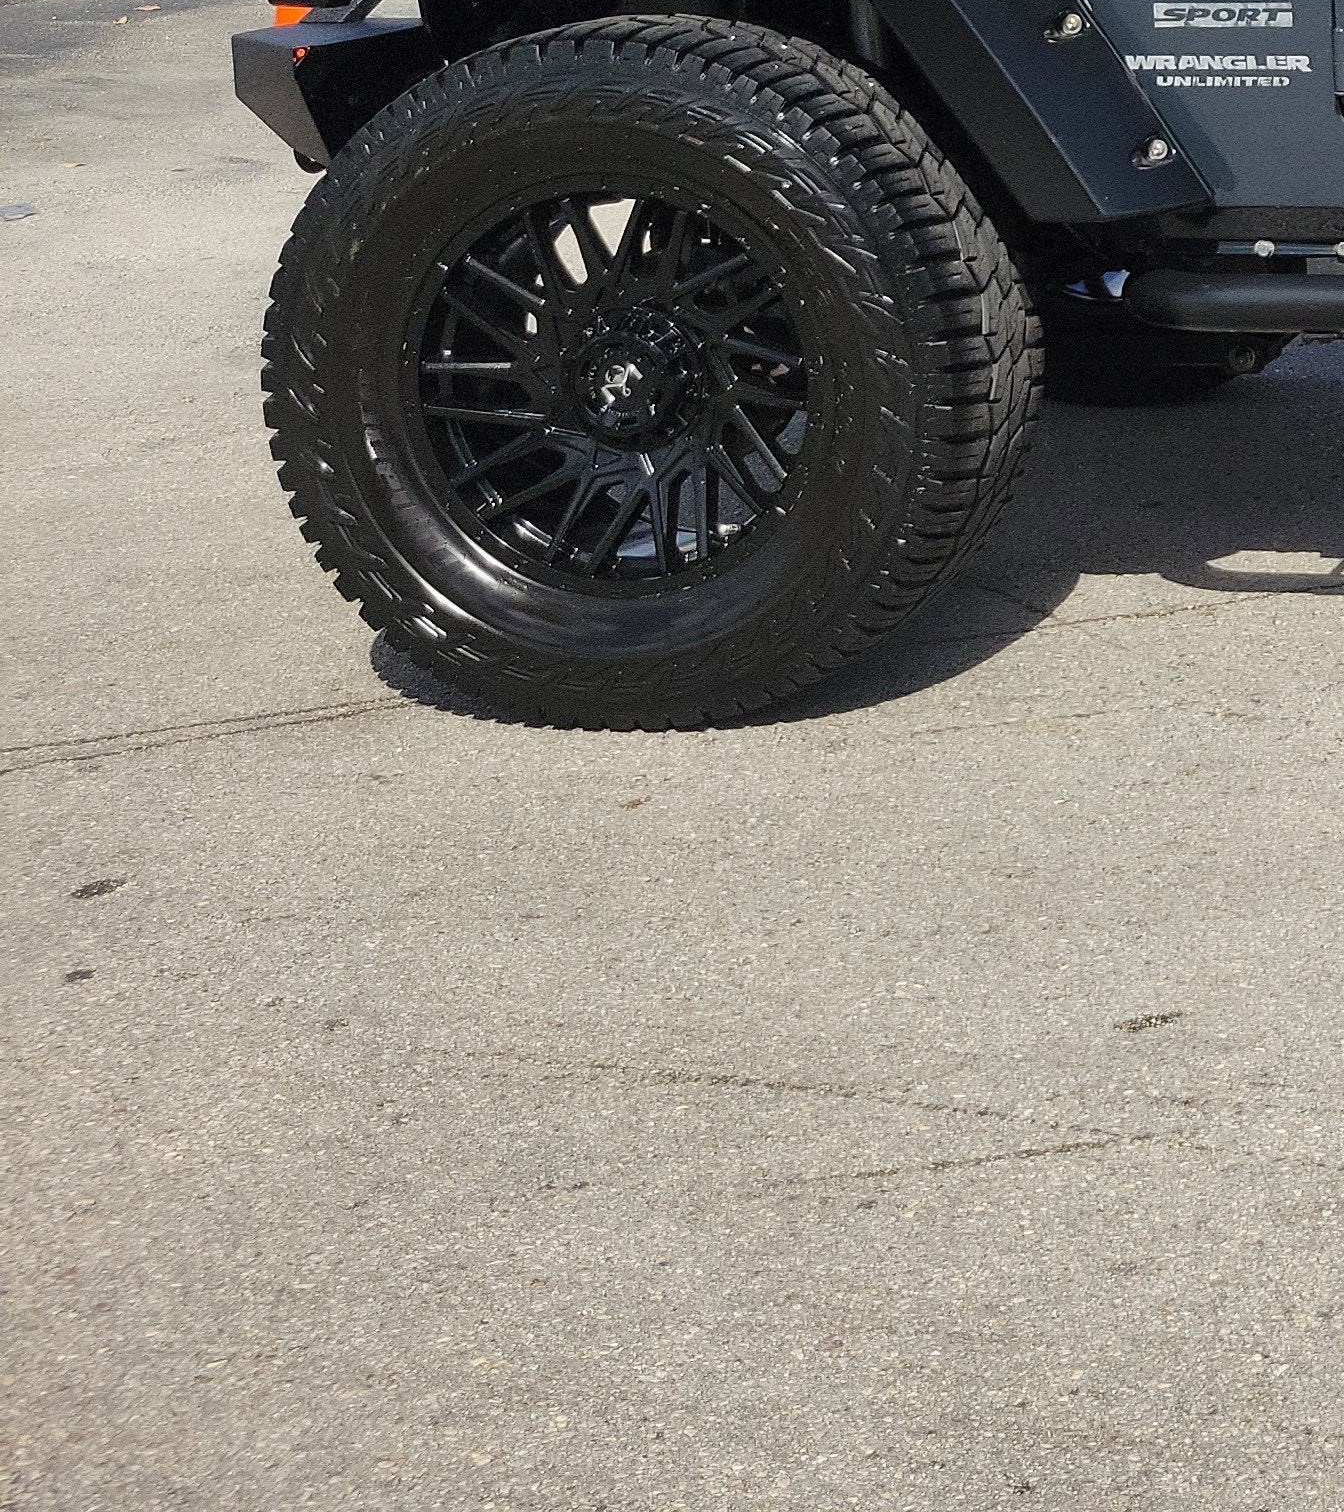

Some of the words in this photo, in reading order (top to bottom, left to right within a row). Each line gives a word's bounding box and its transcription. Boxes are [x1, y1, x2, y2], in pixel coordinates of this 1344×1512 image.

[1154, 5, 1294, 25] SPORT
[1125, 55, 1313, 72] WRANGLER
[1156, 76, 1290, 87] UNLIMITED
